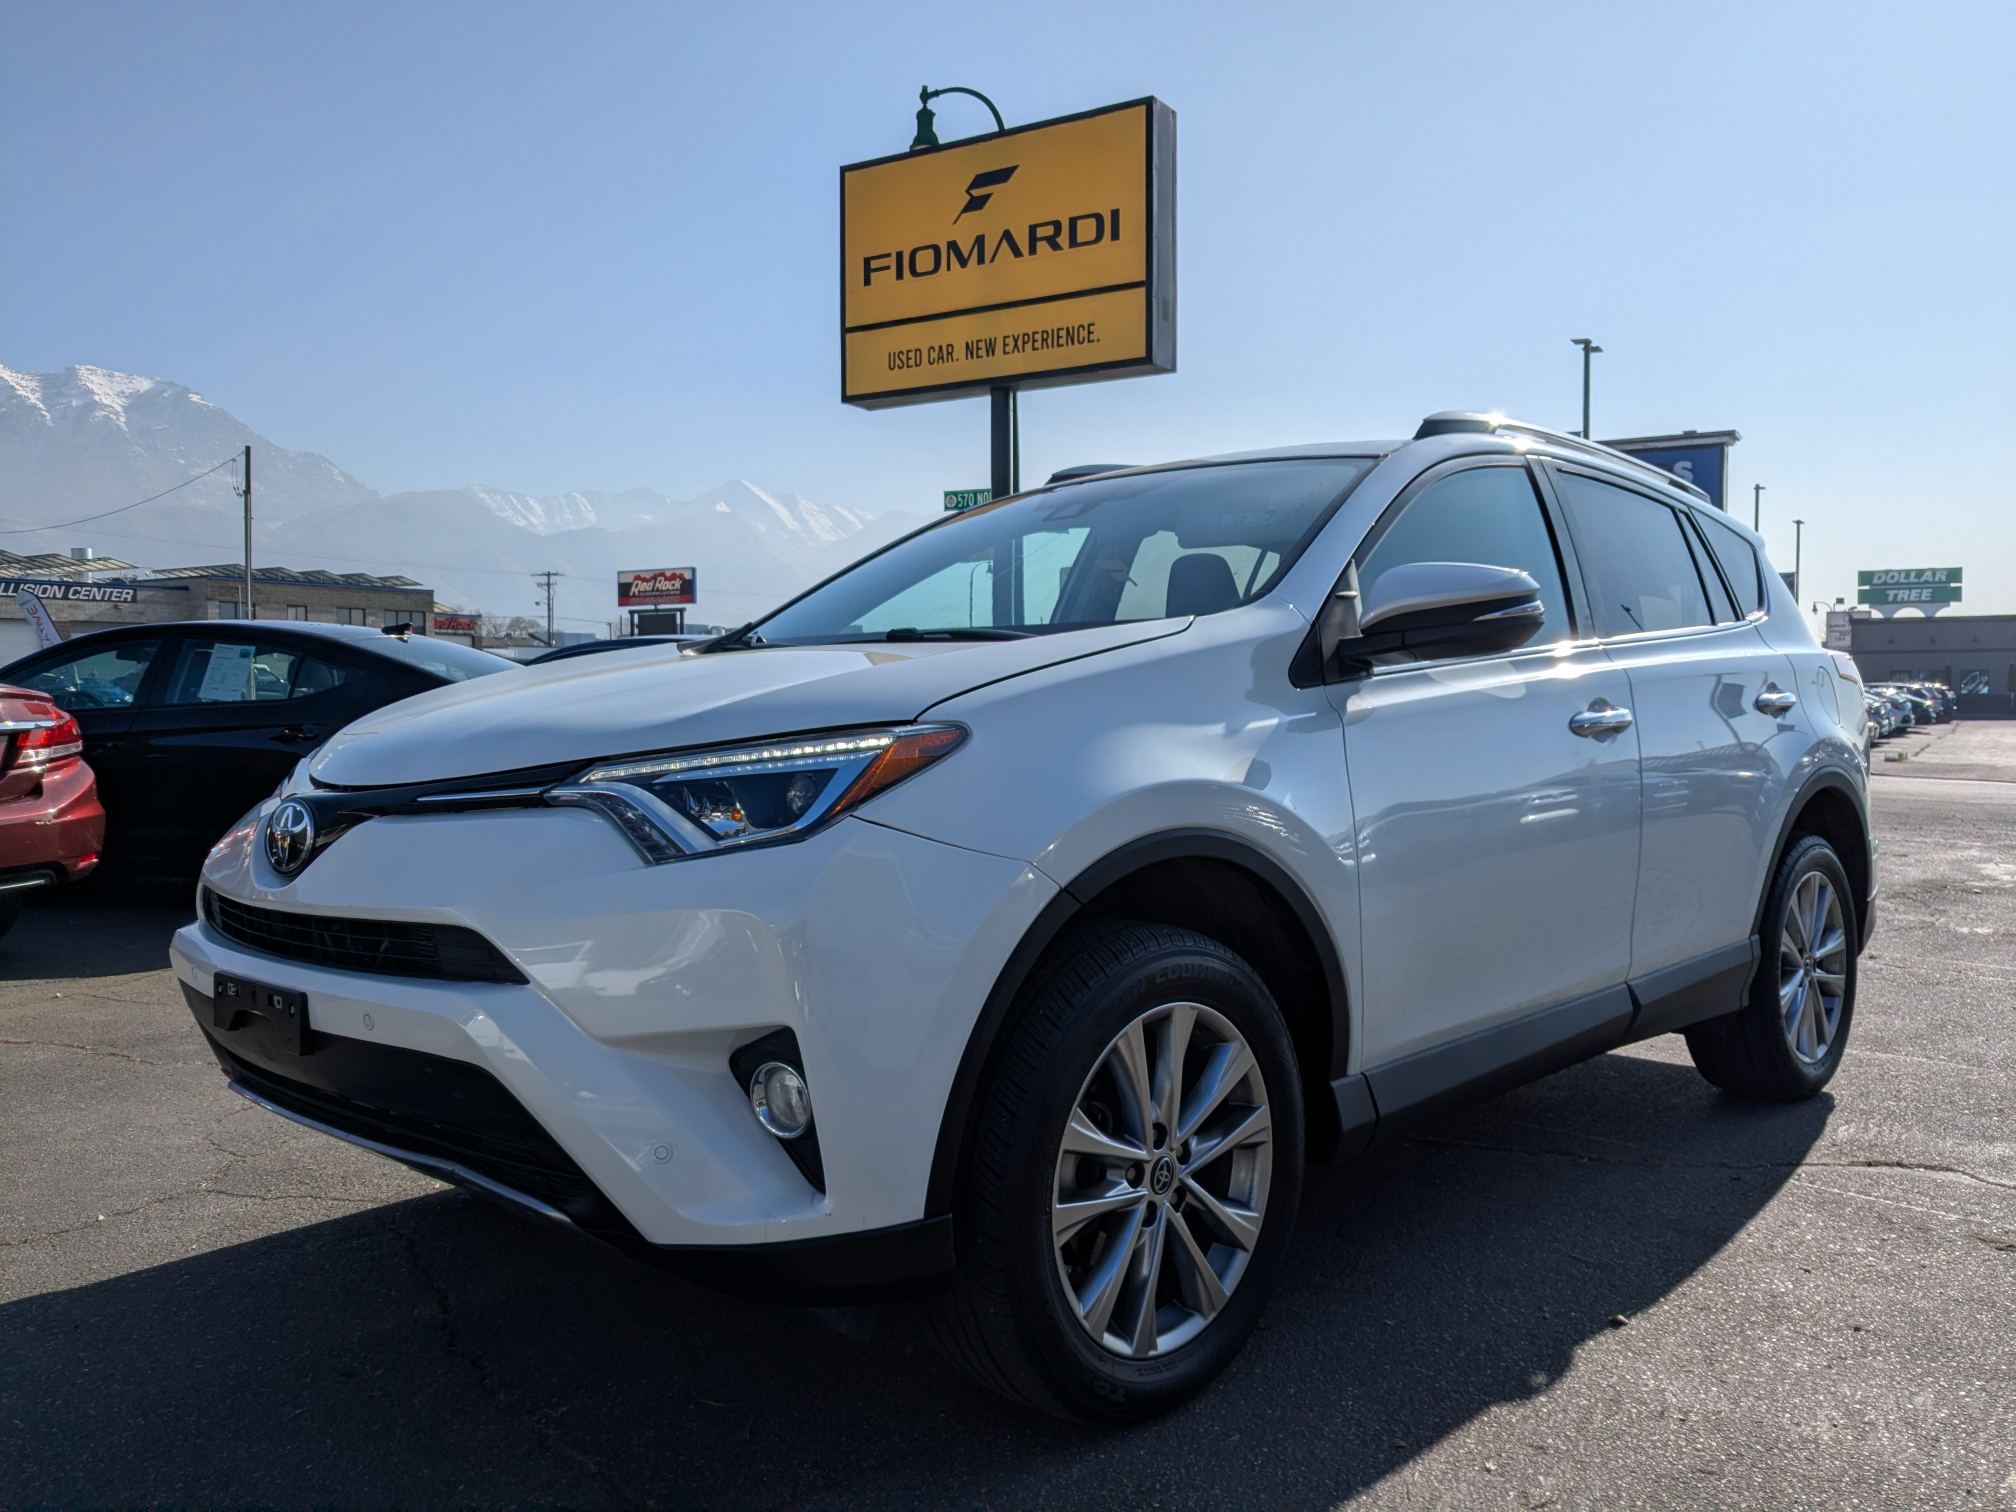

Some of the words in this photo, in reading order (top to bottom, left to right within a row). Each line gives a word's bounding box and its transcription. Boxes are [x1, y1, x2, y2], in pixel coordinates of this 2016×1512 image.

[863, 208, 1120, 287] FIOMARDI
[888, 348, 923, 371] USED
[927, 343, 960, 365] CAR.
[965, 337, 997, 361] NEW
[1002, 323, 1101, 356] EXPERIENCE.
[957, 493, 975, 508] 570
[1872, 570, 1948, 585] DOLLAR
[68, 586, 135, 602] CENTER
[629, 579, 655, 596] Red
[654, 576, 683, 591] Rock
[1886, 589, 1933, 602] TREE
